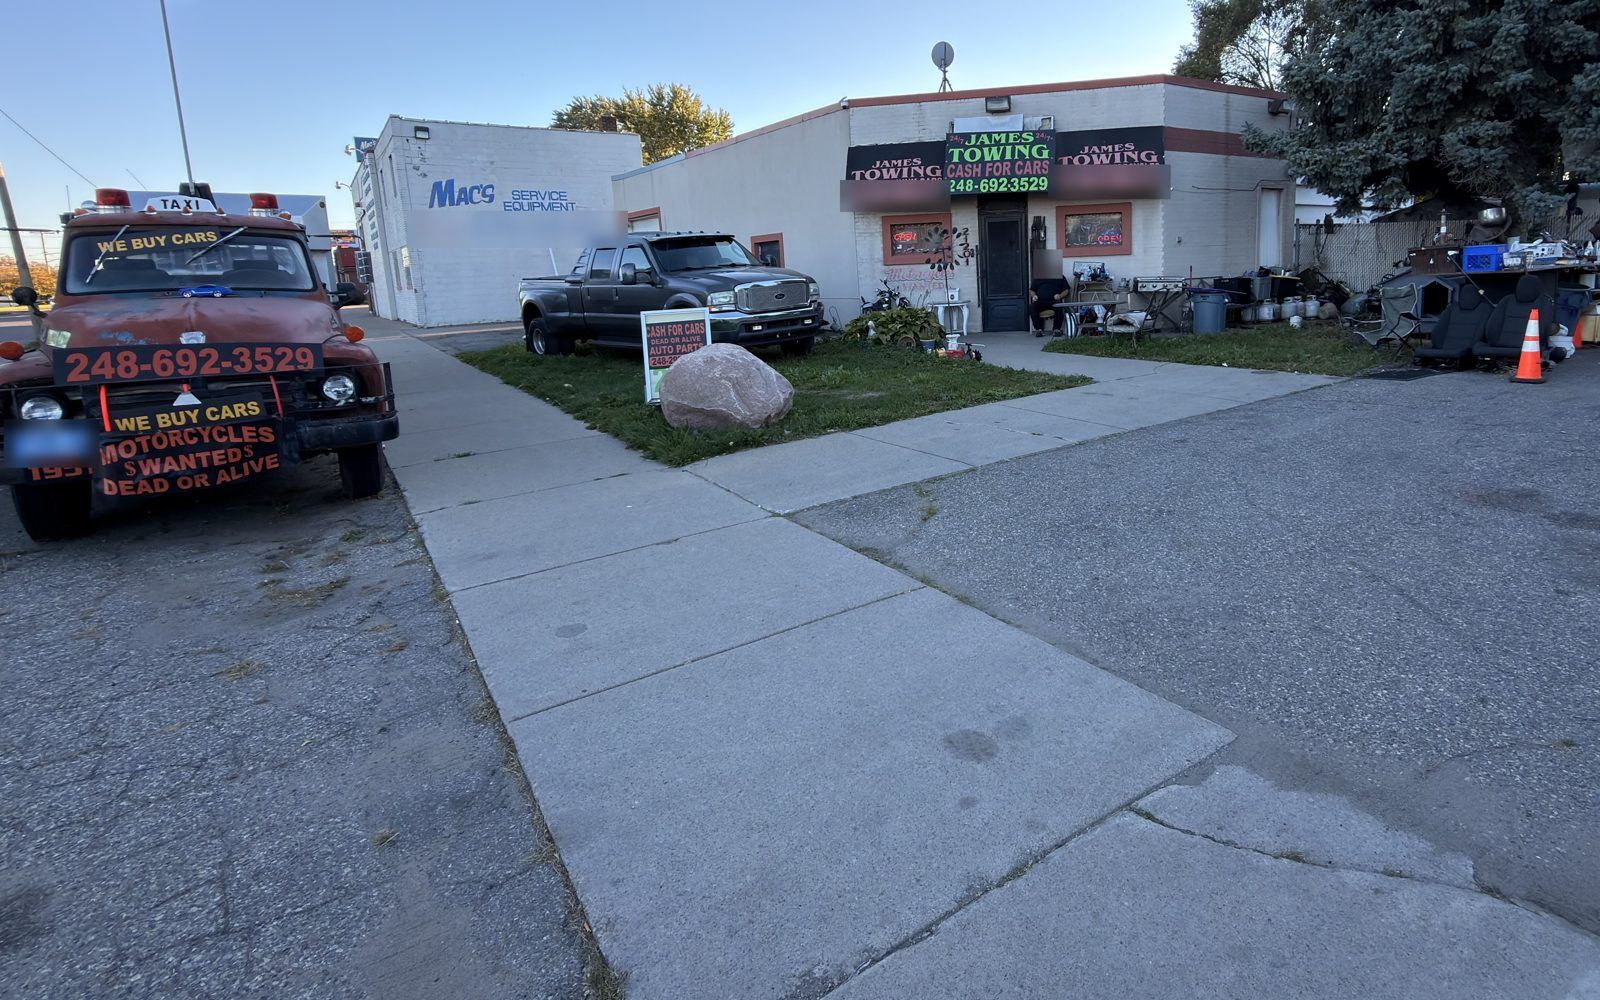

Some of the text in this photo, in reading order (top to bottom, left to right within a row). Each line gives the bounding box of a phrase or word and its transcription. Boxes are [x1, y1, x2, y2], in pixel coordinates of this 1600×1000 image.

[965, 132, 1034, 146] JAMES
[948, 144, 1050, 162] TOWING
[1080, 143, 1135, 154] JAMES
[872, 158, 922, 168] JAMES
[1058, 150, 1158, 165] TOWING
[851, 165, 942, 180] TOWING
[947, 160, 1050, 178] CASH FOR CARS
[950, 177, 1048, 193] 248-692-3529
[511, 190, 568, 201] SERVICE
[161, 199, 200, 210] TAXI
[503, 202, 576, 211] EQUIPMENT
[97, 231, 218, 253] WE BUY CARS
[646, 322, 705, 337] CASH FOR CARS
[650, 345, 674, 356] AUTO
[65, 347, 314, 382] 248-692-3529
[652, 356, 680, 366] 248-29
[115, 401, 260, 432] WE BUY CARS
[99, 425, 276, 466] MOTORCYCLES
[103, 453, 280, 496] DEAD OR ALIVE
